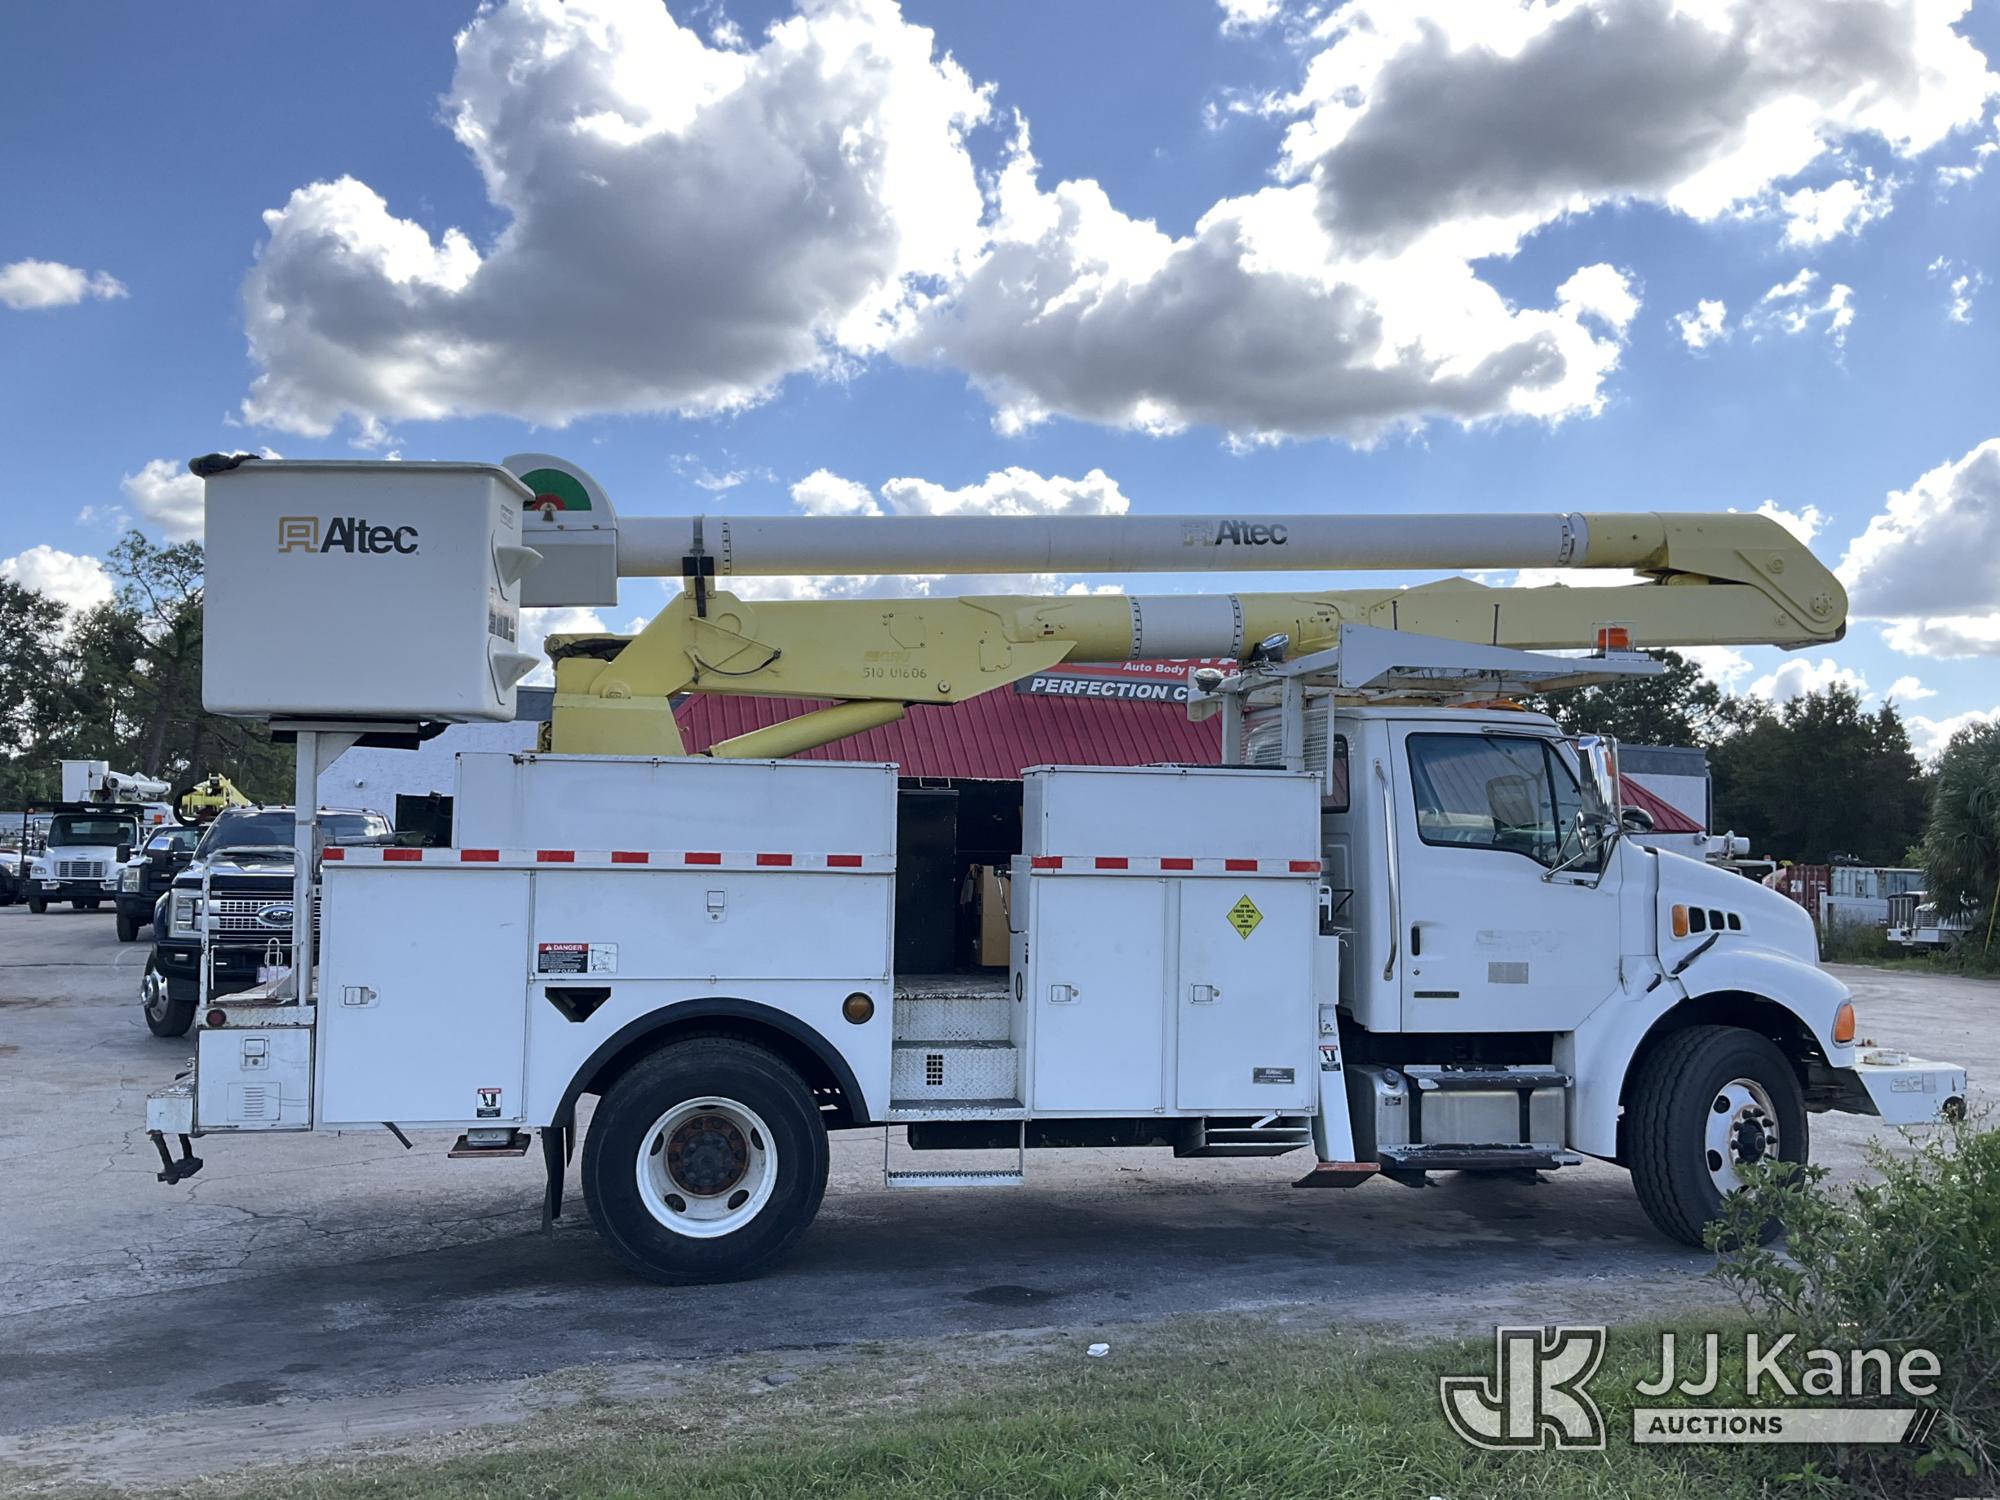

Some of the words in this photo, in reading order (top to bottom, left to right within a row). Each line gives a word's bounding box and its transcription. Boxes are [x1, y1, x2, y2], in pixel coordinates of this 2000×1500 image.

[320, 517, 418, 554] Altec
[1215, 520, 1288, 545] Altec
[864, 667, 884, 678] 510
[1123, 662, 1152, 673] Auto
[1155, 664, 1185, 676] Body
[1031, 678, 1167, 699] PERFECTION
